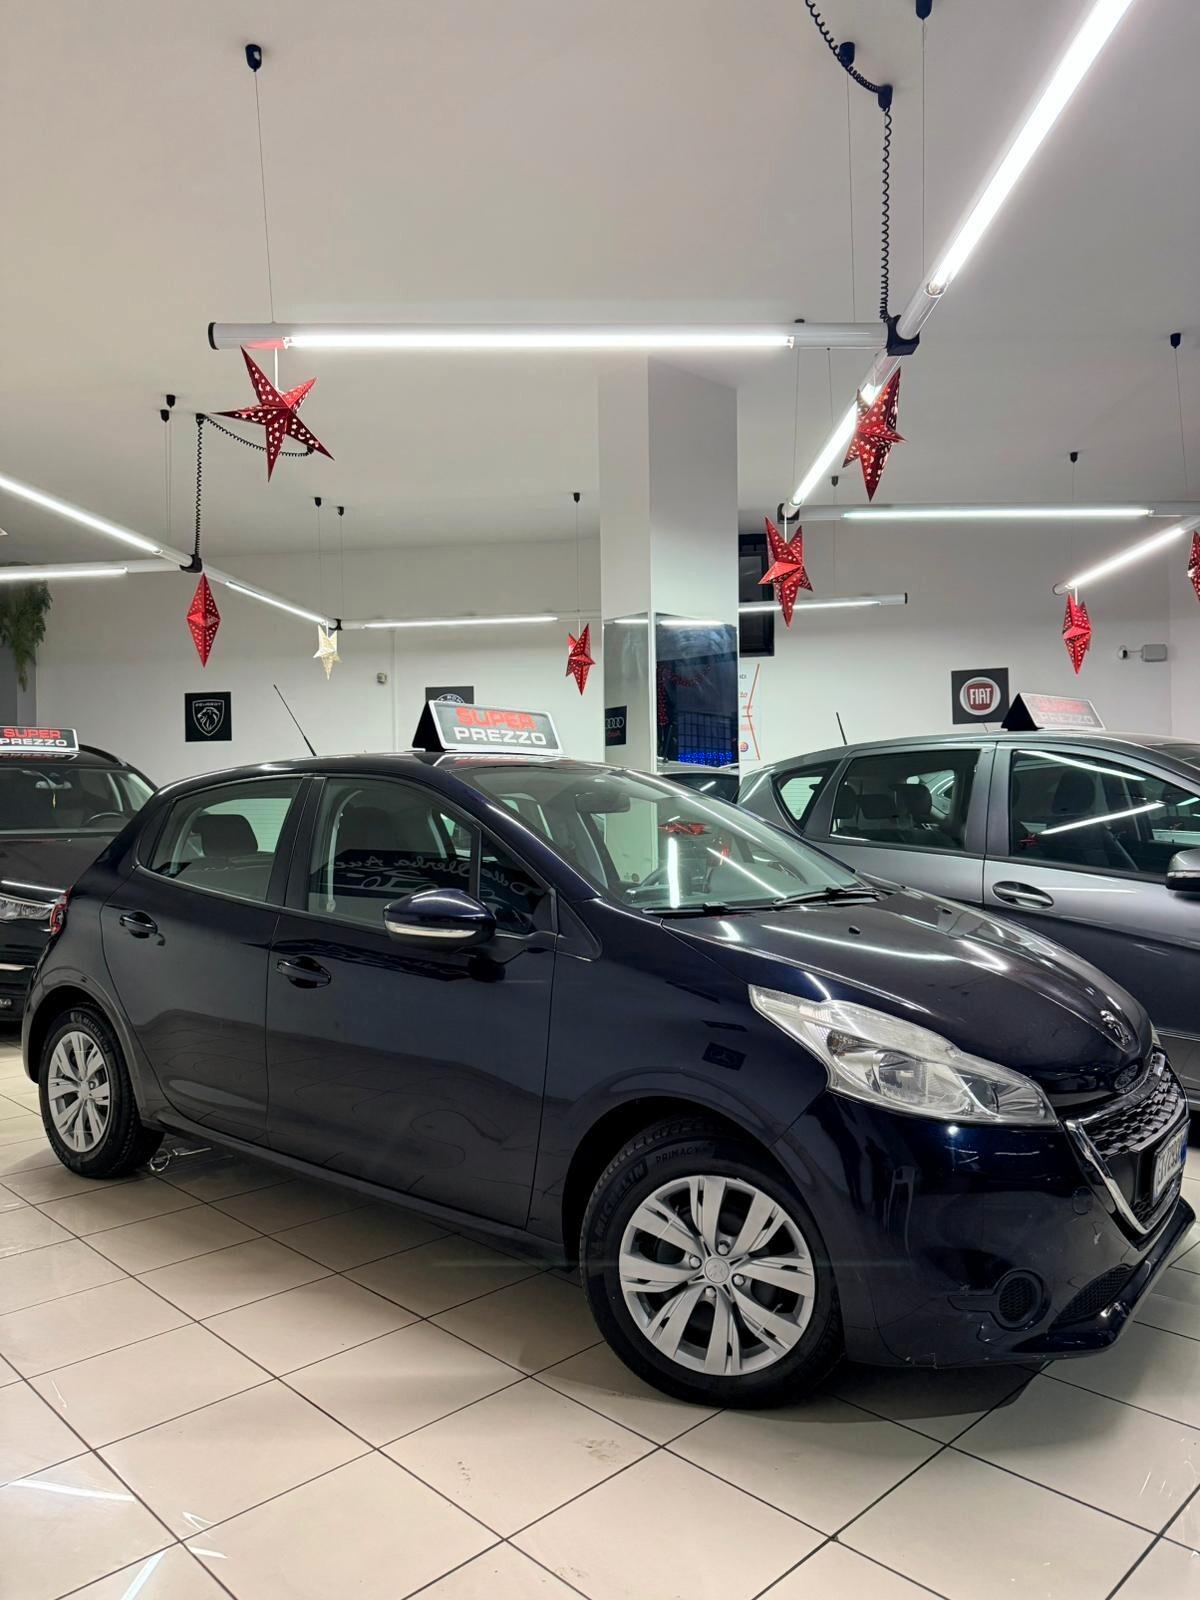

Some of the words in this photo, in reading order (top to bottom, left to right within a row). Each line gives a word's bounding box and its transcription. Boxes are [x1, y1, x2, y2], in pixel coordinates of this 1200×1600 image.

[969, 687, 993, 705] FIAT
[455, 707, 536, 730] SUPER
[1040, 713, 1094, 724] PREZZO
[3, 728, 61, 738] SUPER
[453, 726, 547, 745] PREZZO
[0, 738, 68, 747] PREZZO
[656, 1147, 699, 1163] PRIMACY
